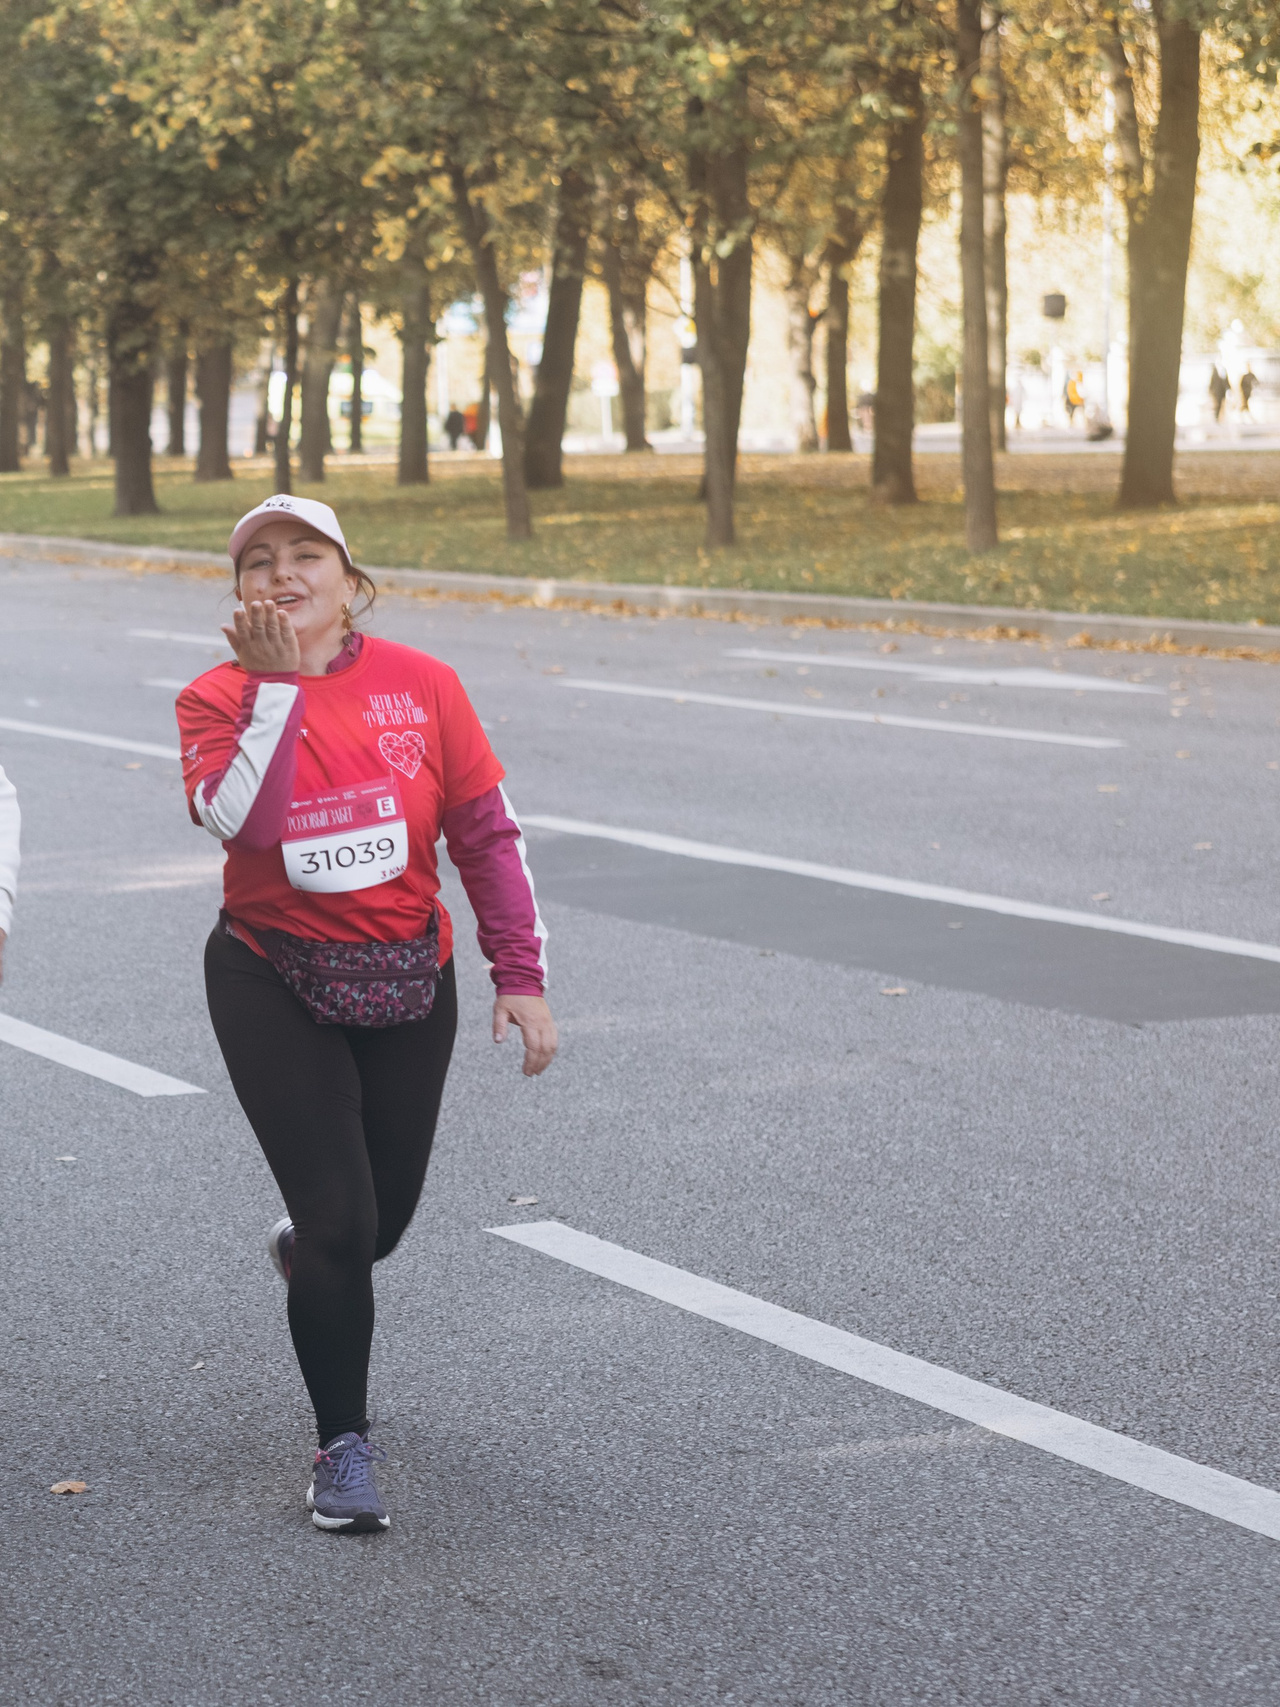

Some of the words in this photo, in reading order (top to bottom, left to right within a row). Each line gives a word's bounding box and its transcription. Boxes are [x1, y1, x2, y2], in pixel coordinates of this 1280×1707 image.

[369, 694, 393, 711] БЕГИ
[393, 691, 415, 709] КАК
[362, 706, 429, 729] ЧУВСТВУЕШЬ
[381, 798, 392, 812] E
[287, 808, 329, 833] РОЗОВЫЙ
[329, 804, 353, 826] ЗАБЕГ
[300, 838, 395, 874] 31039
